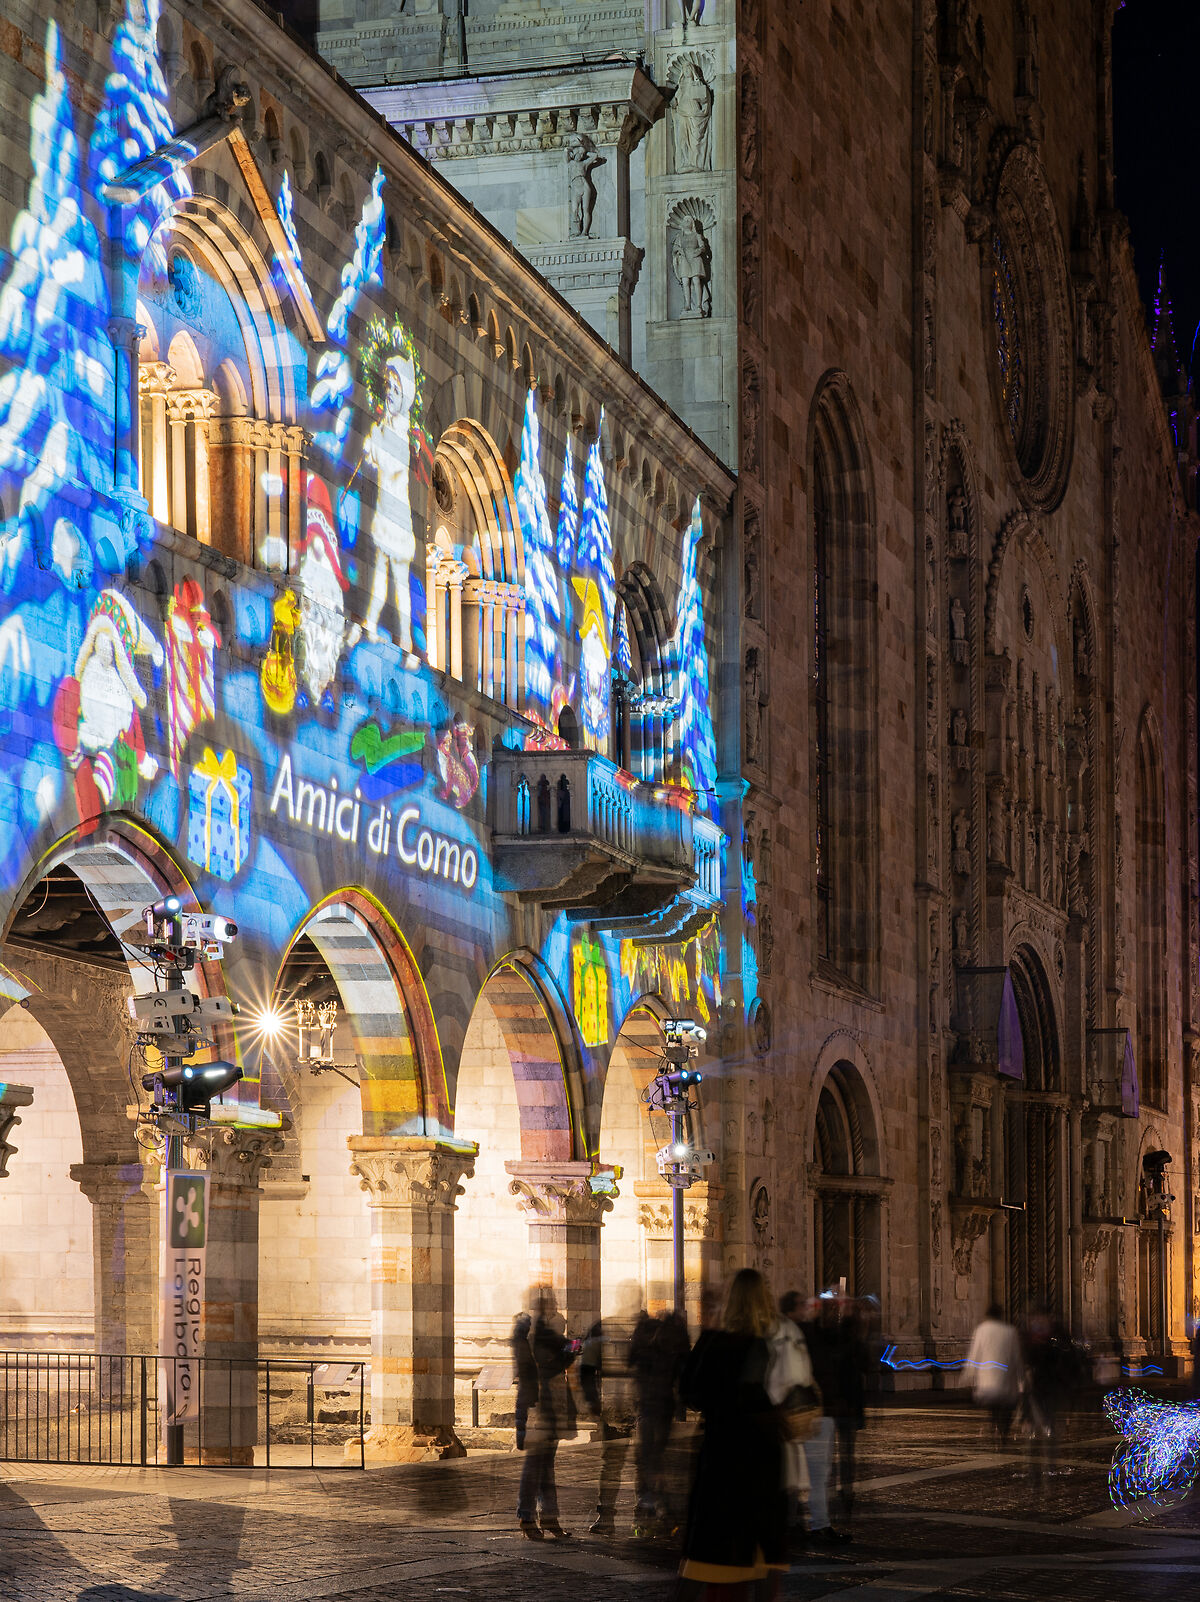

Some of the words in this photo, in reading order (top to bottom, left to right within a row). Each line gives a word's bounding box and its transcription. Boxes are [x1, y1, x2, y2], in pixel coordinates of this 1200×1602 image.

[270, 754, 360, 843] Amici
[367, 804, 391, 855] di
[397, 808, 477, 888] Como
